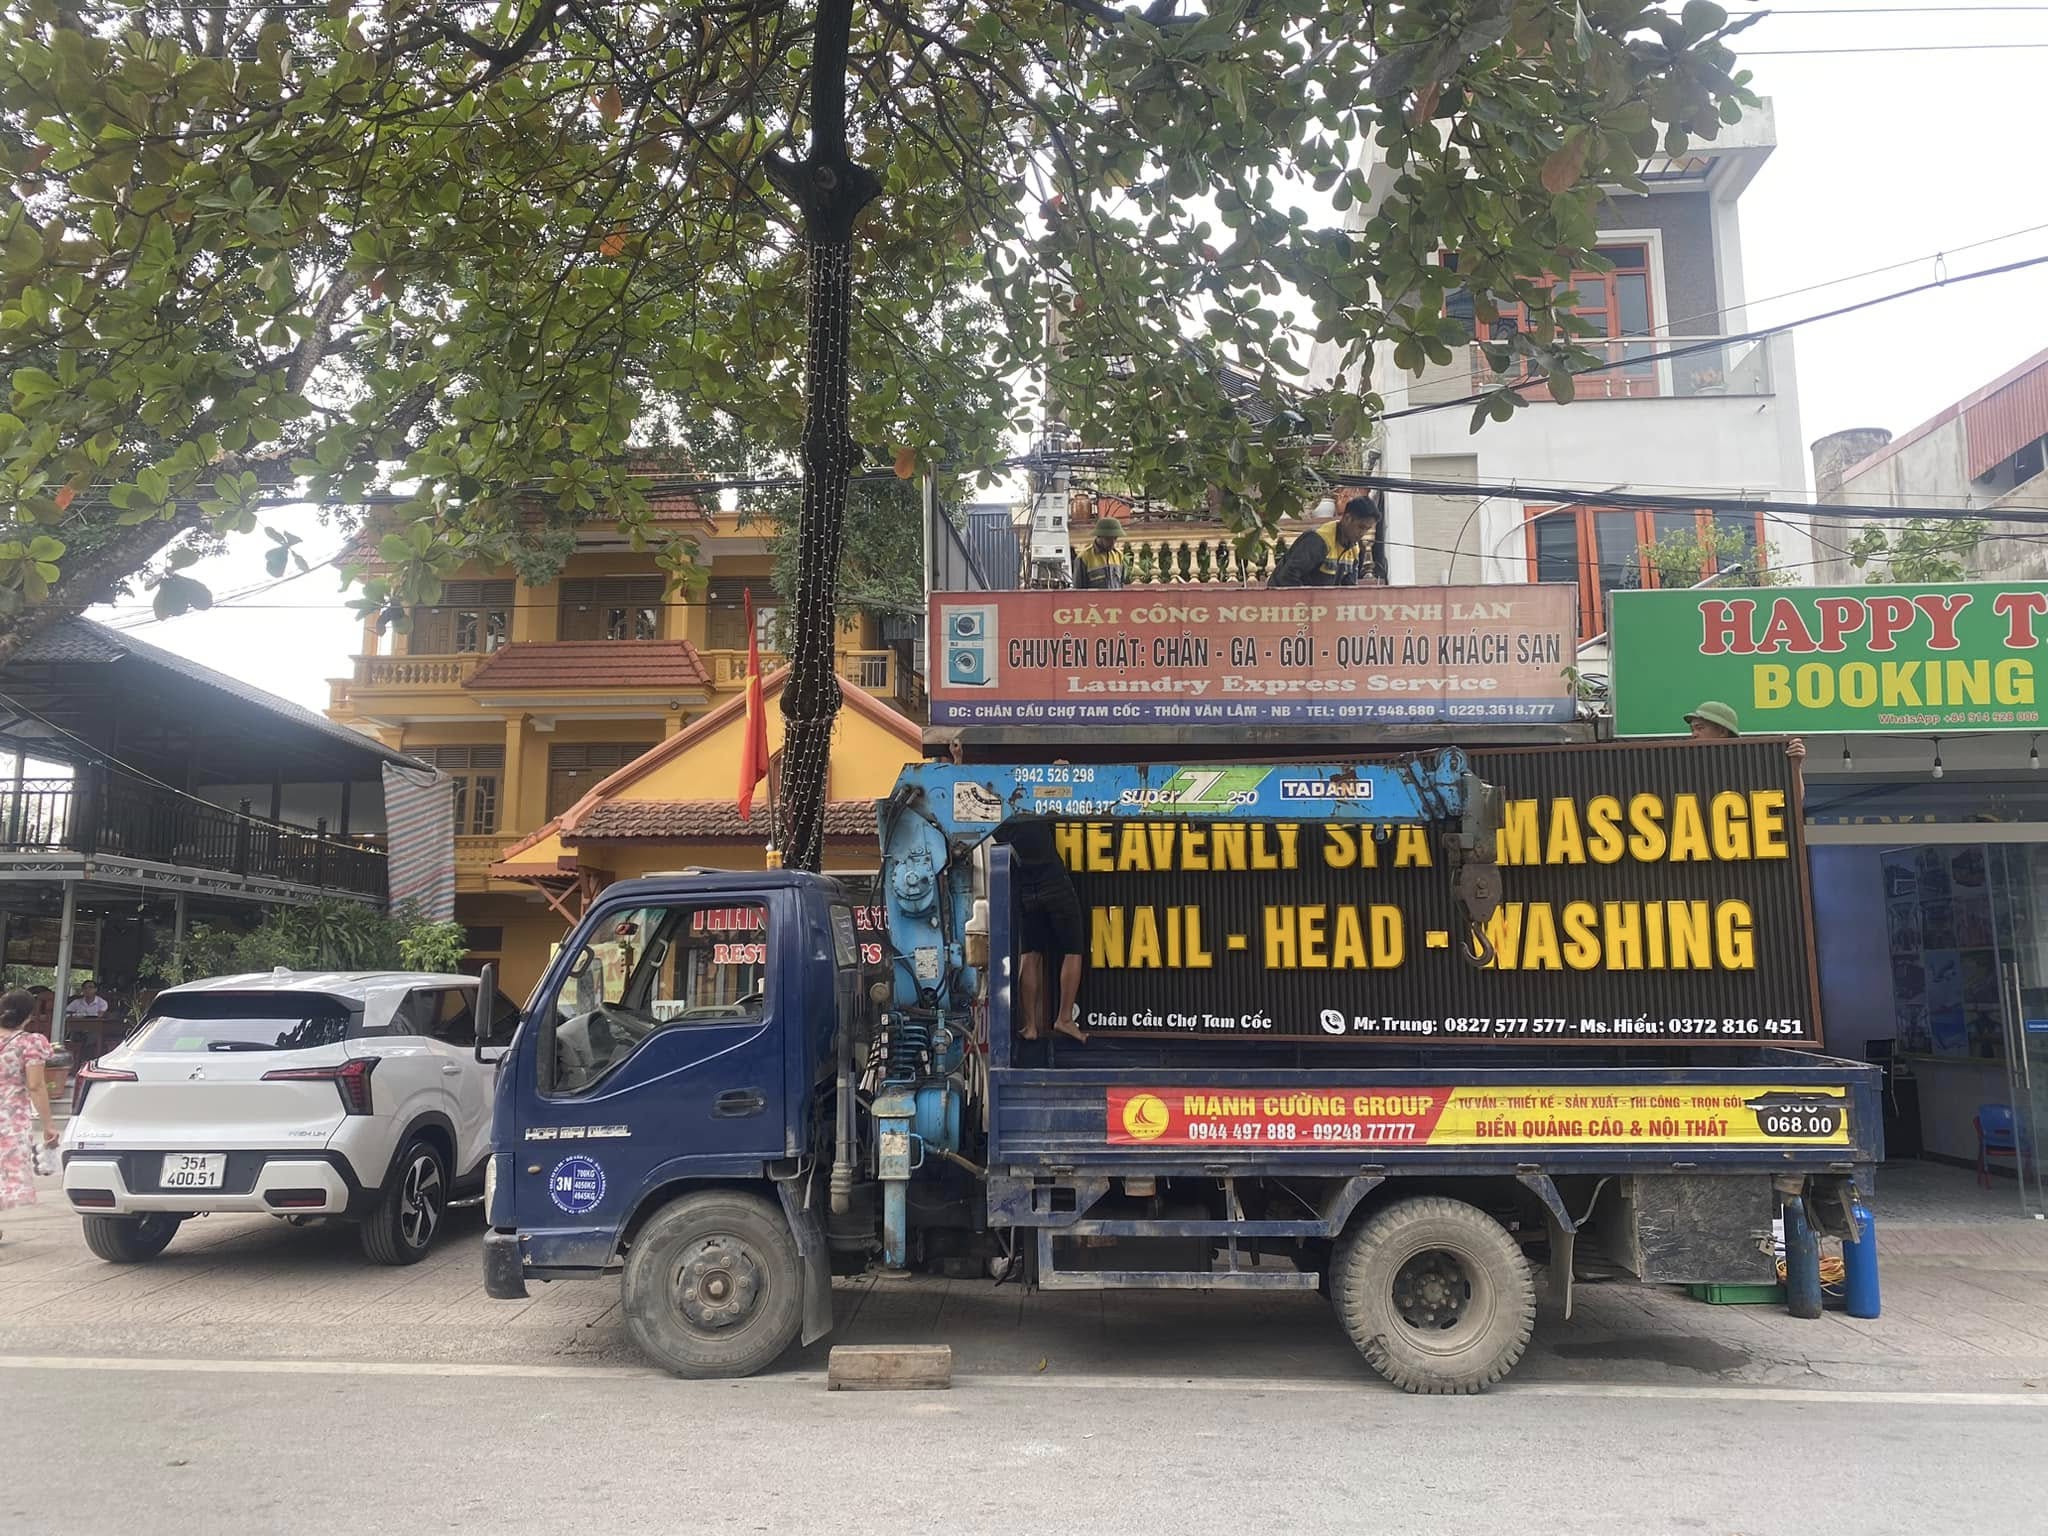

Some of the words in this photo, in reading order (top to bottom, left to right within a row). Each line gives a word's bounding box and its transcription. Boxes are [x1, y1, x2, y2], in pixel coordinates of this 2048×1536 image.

[1053, 603, 1122, 627] GIẶT
[1130, 602, 1209, 624] CÔNG
[1218, 602, 1327, 627] NGHIỆP
[1451, 602, 1512, 621] LAN
[1698, 594, 1973, 655] HAPPY
[1993, 592, 2048, 649] T
[1008, 632, 1088, 669] CHUYÊN
[1095, 632, 1146, 674] GIẶT:
[1152, 631, 1208, 668] CHĂN
[1230, 637, 1258, 667] GA
[1402, 629, 1430, 666] ÁO
[1438, 628, 1508, 666] KHÁCH
[1516, 632, 1561, 671] SẠN
[1067, 675, 1212, 695] Laundry
[1221, 675, 1356, 695] Express
[1367, 675, 1497, 692] Service
[1753, 659, 2035, 709] BOOKING
[1079, 706, 1108, 717] TAM
[1154, 703, 1190, 717] THÔN
[1271, 706, 1291, 717] NB
[1306, 705, 1335, 717] TEL:
[1879, 713, 1940, 725] WhatsApp
[1015, 768, 1043, 783] 0942
[1047, 768, 1069, 783] 526
[1072, 768, 1095, 783] 298
[1120, 788, 1181, 806] super
[1226, 790, 1259, 805] 250
[1284, 781, 1370, 797] TADANO
[1056, 822, 1299, 872] HEAVENLY
[1495, 790, 1790, 867] MASSAGE
[1091, 904, 1213, 970] NAIL
[1264, 904, 1405, 970] HEAD
[1471, 900, 1756, 971] WASHING
[1087, 1011, 1128, 1028] Chân
[1132, 1009, 1163, 1029] Cầu
[1166, 1013, 1197, 1032] Chợ
[1201, 1014, 1235, 1029] Tam
[1240, 1009, 1272, 1030] Cốc
[1445, 1017, 1490, 1034] 0827
[1494, 1018, 1528, 1035] 577
[1532, 1018, 1566, 1035] 577
[1668, 1018, 1718, 1035] 0372
[1722, 1018, 1759, 1035] 816
[1764, 1018, 1804, 1035] 451
[1184, 1095, 1256, 1120] MẠNH
[1264, 1092, 1346, 1117] CƯỜNG
[1353, 1095, 1434, 1117] GROUP
[1508, 1094, 1537, 1109] THIẾT
[1540, 1094, 1555, 1108] KẾ
[1565, 1093, 1588, 1109] SẢN
[1650, 1094, 1681, 1108] CÔNG
[1188, 1123, 1228, 1140] 0944
[1233, 1123, 1262, 1140] 497
[1267, 1123, 1296, 1140] 888
[1313, 1123, 1361, 1140] 09248
[1367, 1123, 1416, 1140] 77777
[1476, 1113, 1517, 1137] BIỂN
[1522, 1114, 1583, 1138] QUẢNG
[1630, 1119, 1642, 1136] &
[1685, 1113, 1729, 1137] THẤT
[1767, 1116, 1832, 1134] 068.00
[181, 1156, 207, 1170] 35A
[167, 1171, 216, 1186] 400.51
[556, 1176, 572, 1192] 3N
